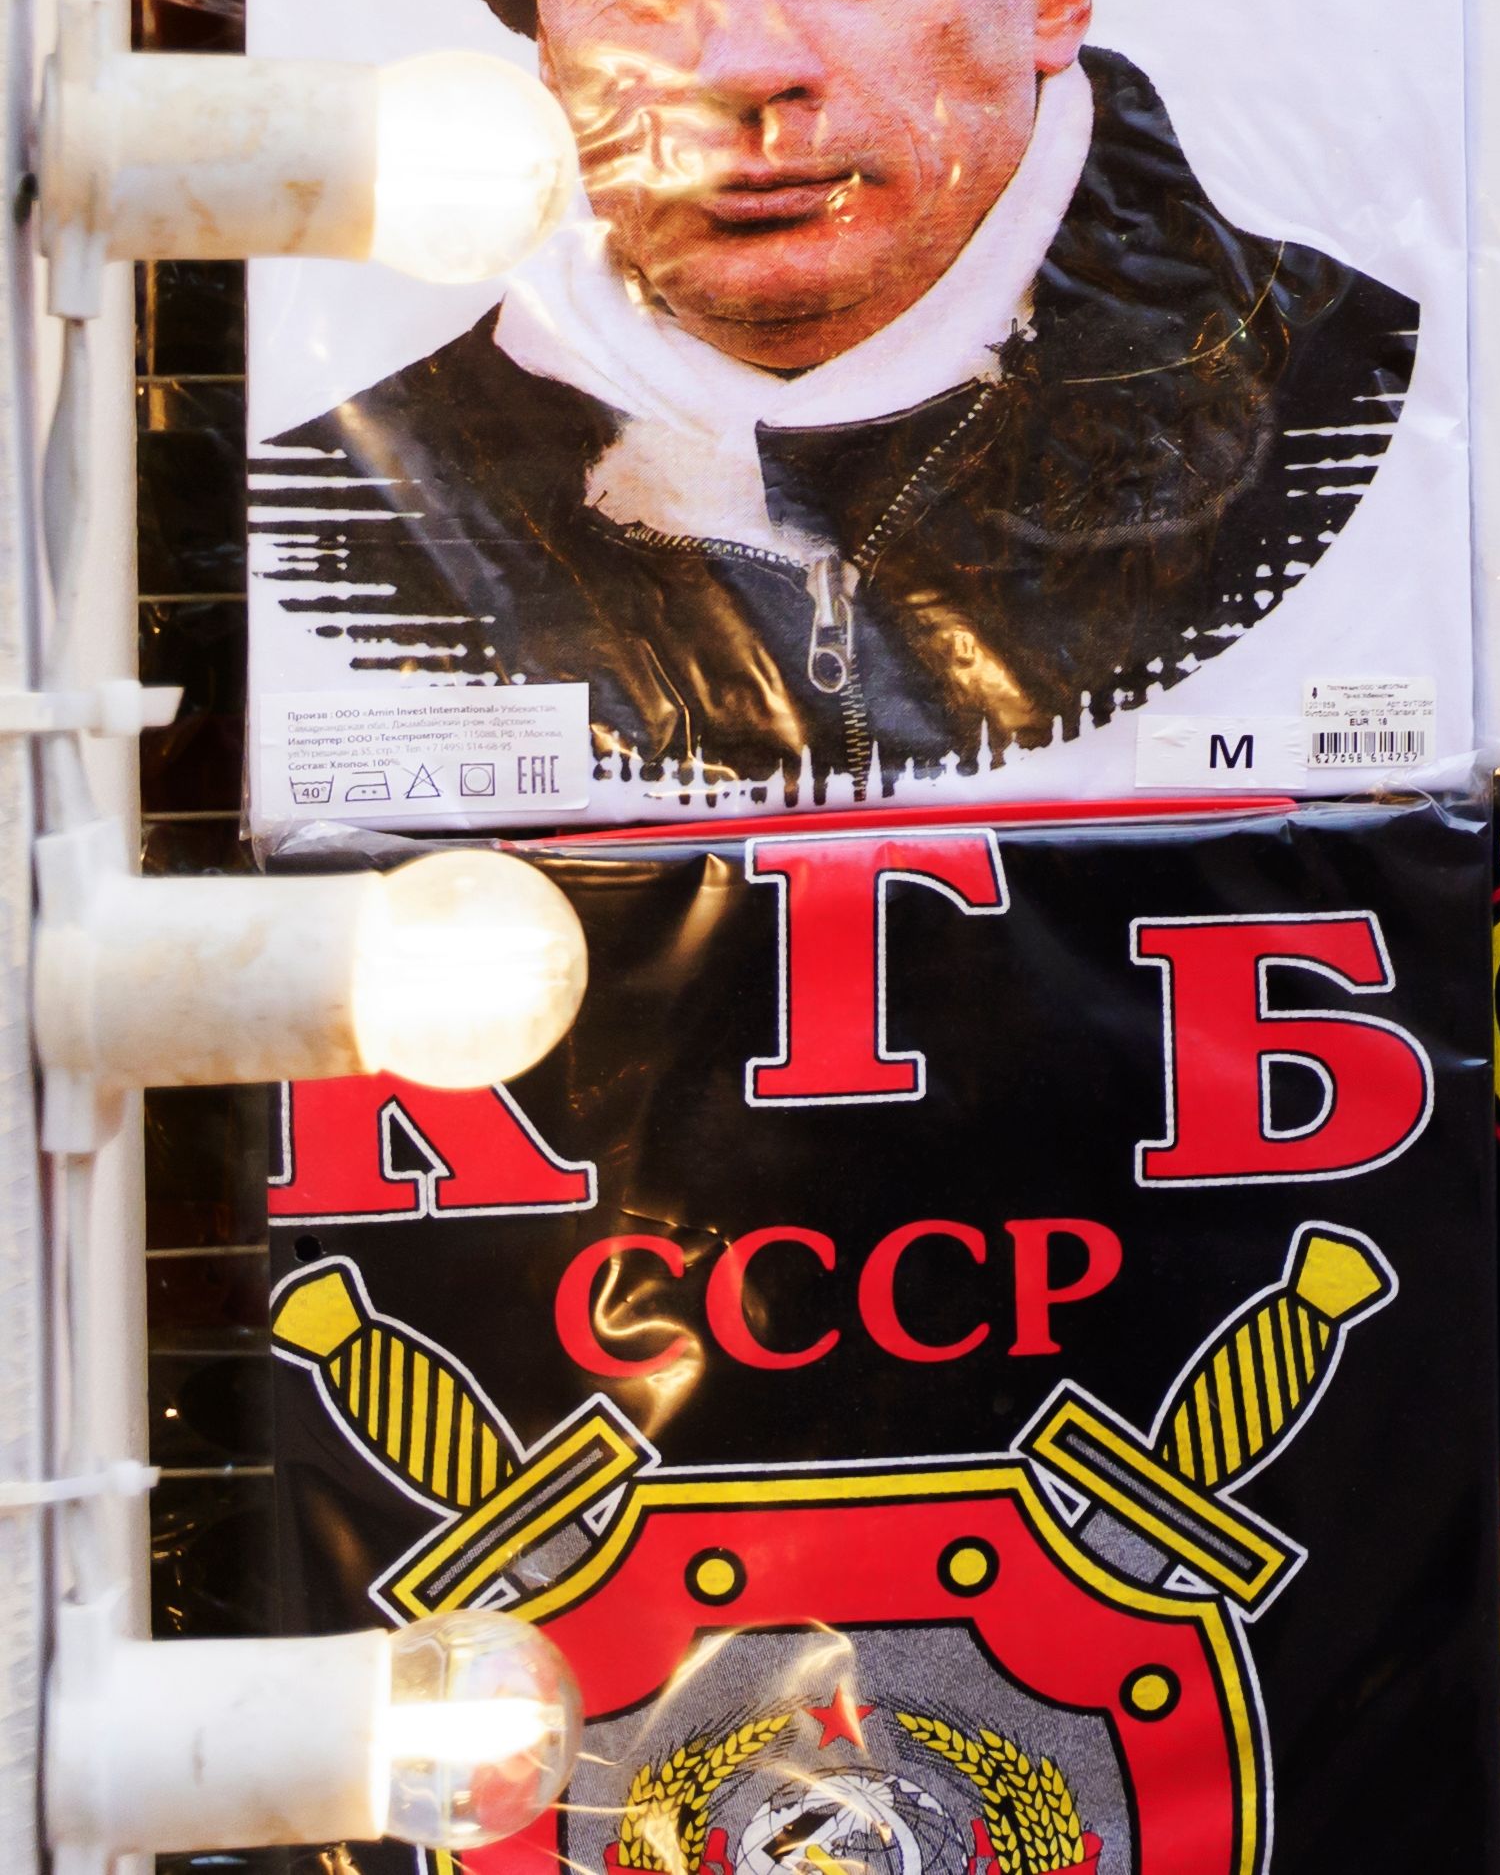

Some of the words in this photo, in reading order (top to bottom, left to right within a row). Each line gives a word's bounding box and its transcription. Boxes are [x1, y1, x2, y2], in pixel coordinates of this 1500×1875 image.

[1350, 718, 1369, 726] EUR
[1209, 734, 1254, 769] M
[553, 1217, 1122, 1376] СССР
